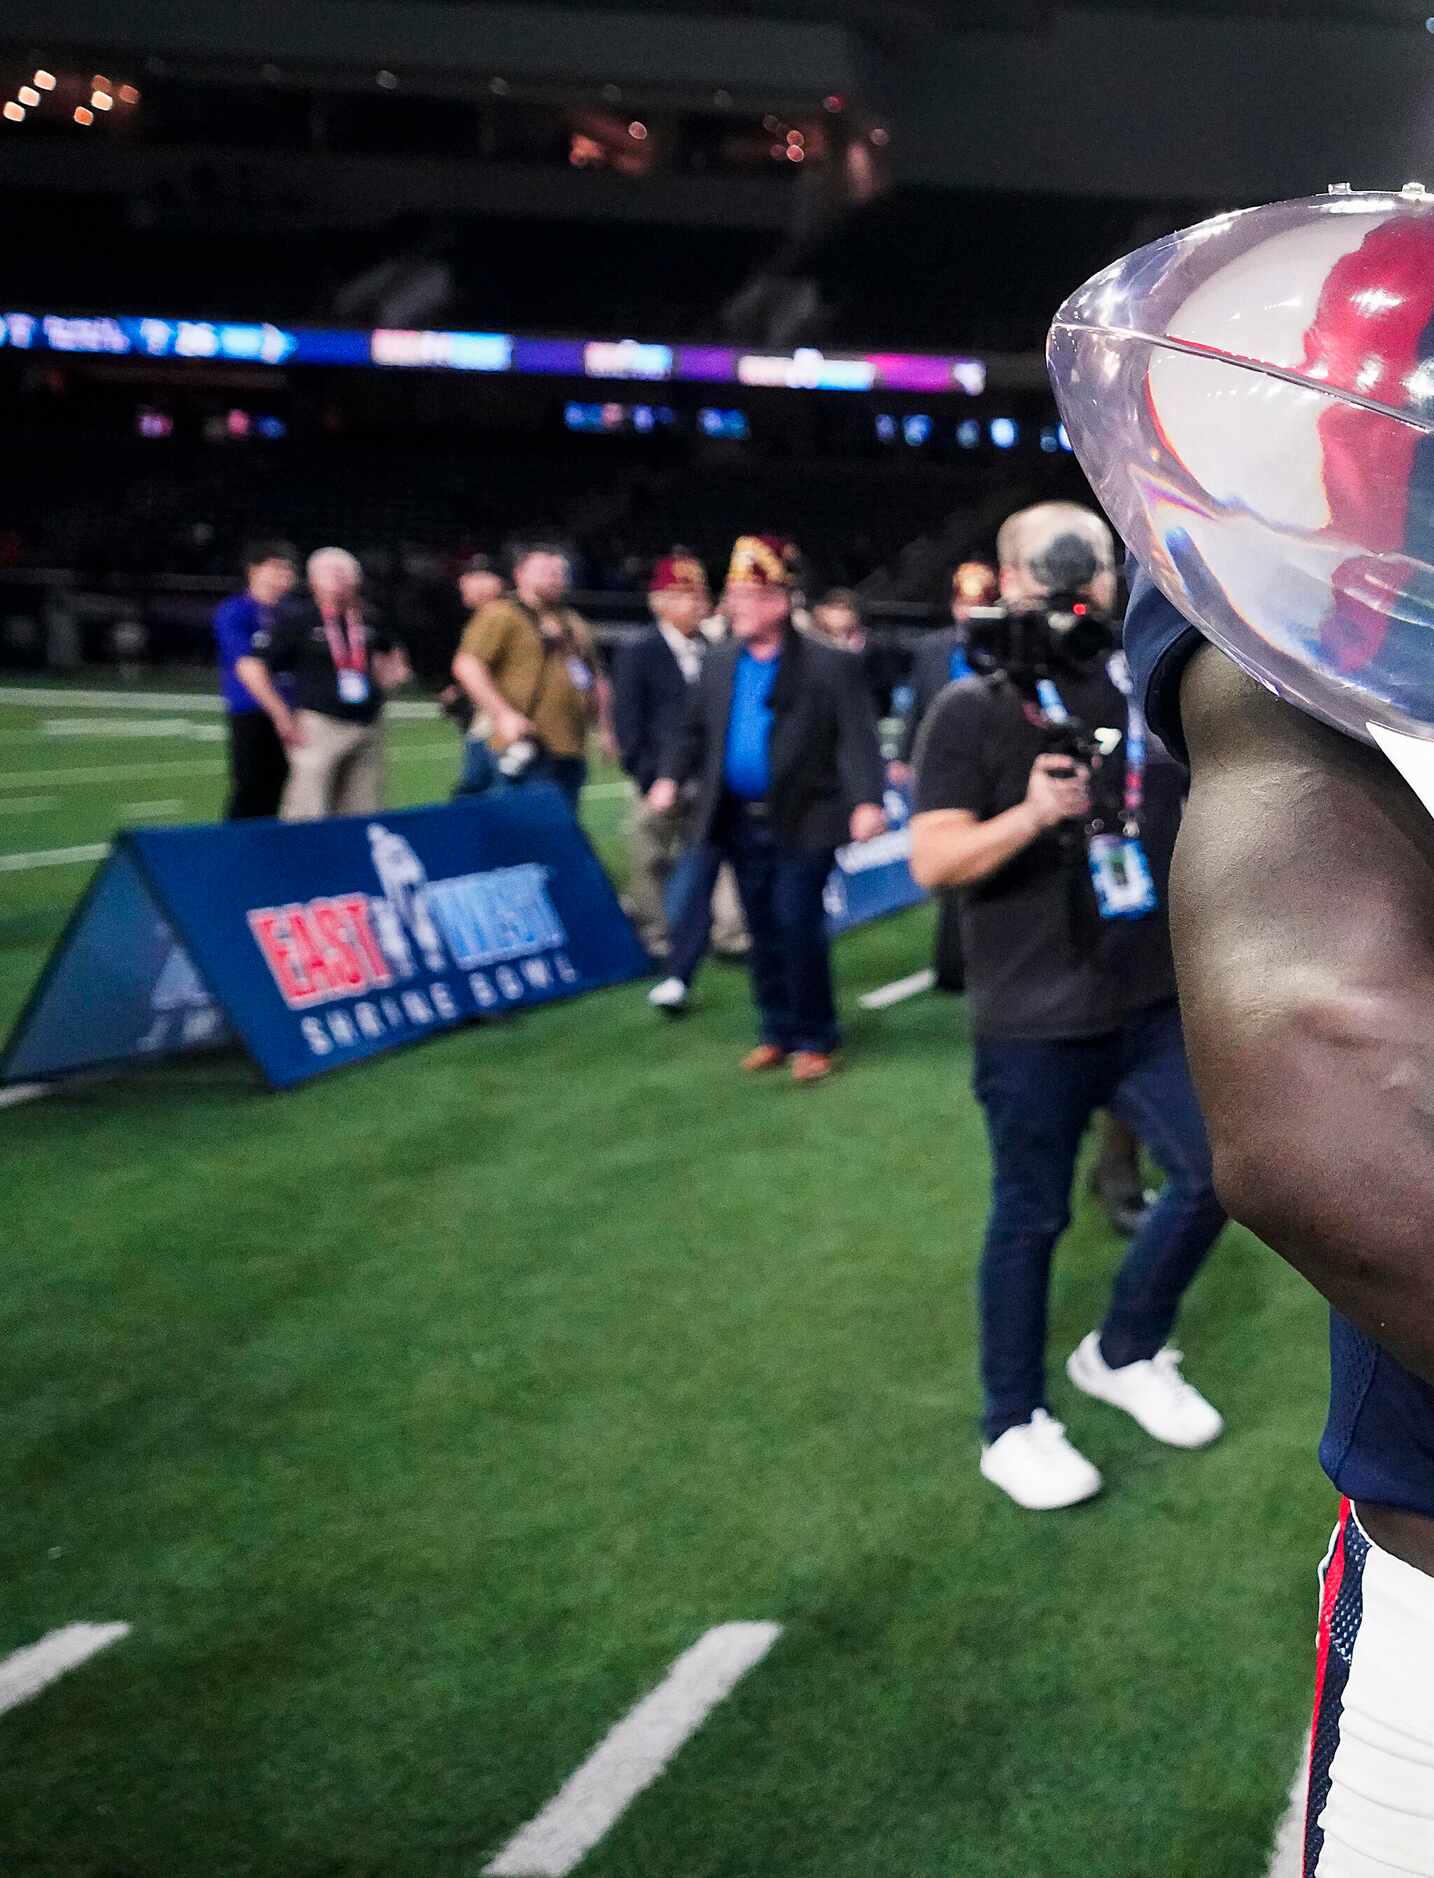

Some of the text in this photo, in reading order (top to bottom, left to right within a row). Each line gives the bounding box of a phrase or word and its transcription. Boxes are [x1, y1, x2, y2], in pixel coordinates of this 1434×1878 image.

[247, 891, 397, 1010] EAST
[301, 951, 578, 1056] SHRINE BOWL
